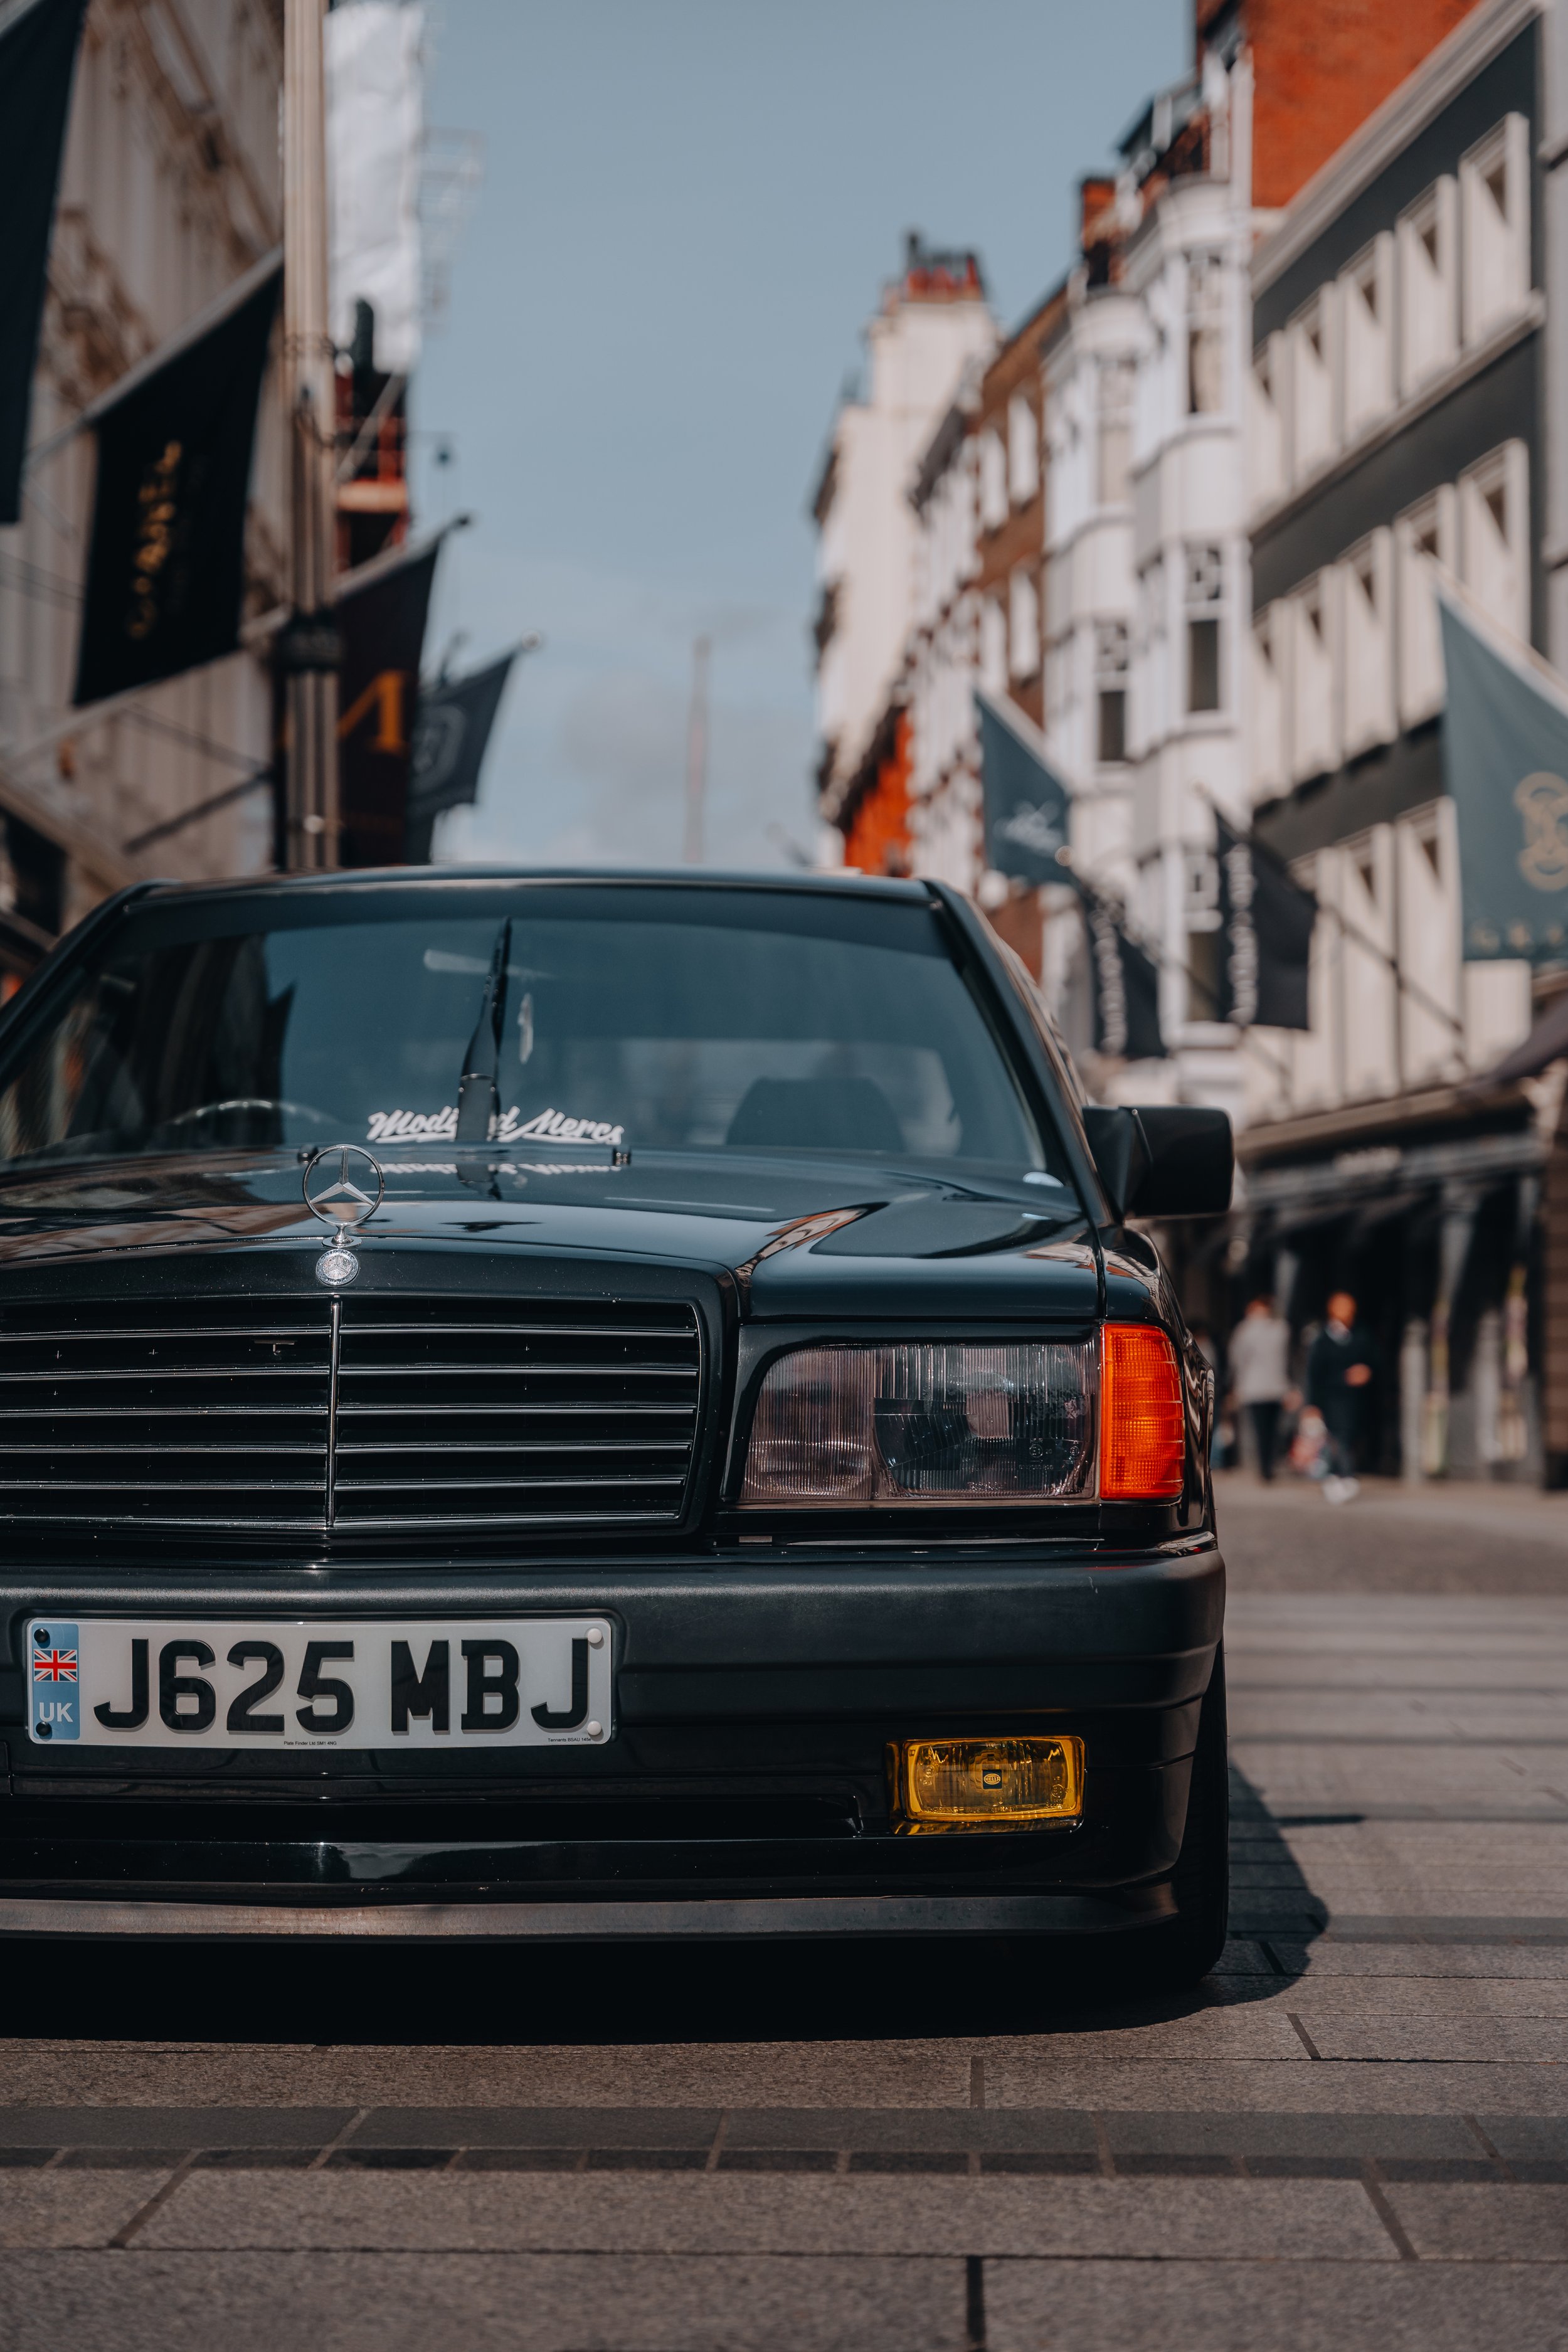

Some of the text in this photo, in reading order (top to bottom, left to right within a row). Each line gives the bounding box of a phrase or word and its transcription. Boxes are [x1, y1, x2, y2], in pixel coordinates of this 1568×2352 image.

[366, 1105, 625, 1145] Modid Mercs
[93, 1638, 589, 1732] J625 MBJ
[39, 1702, 73, 1722] UK
